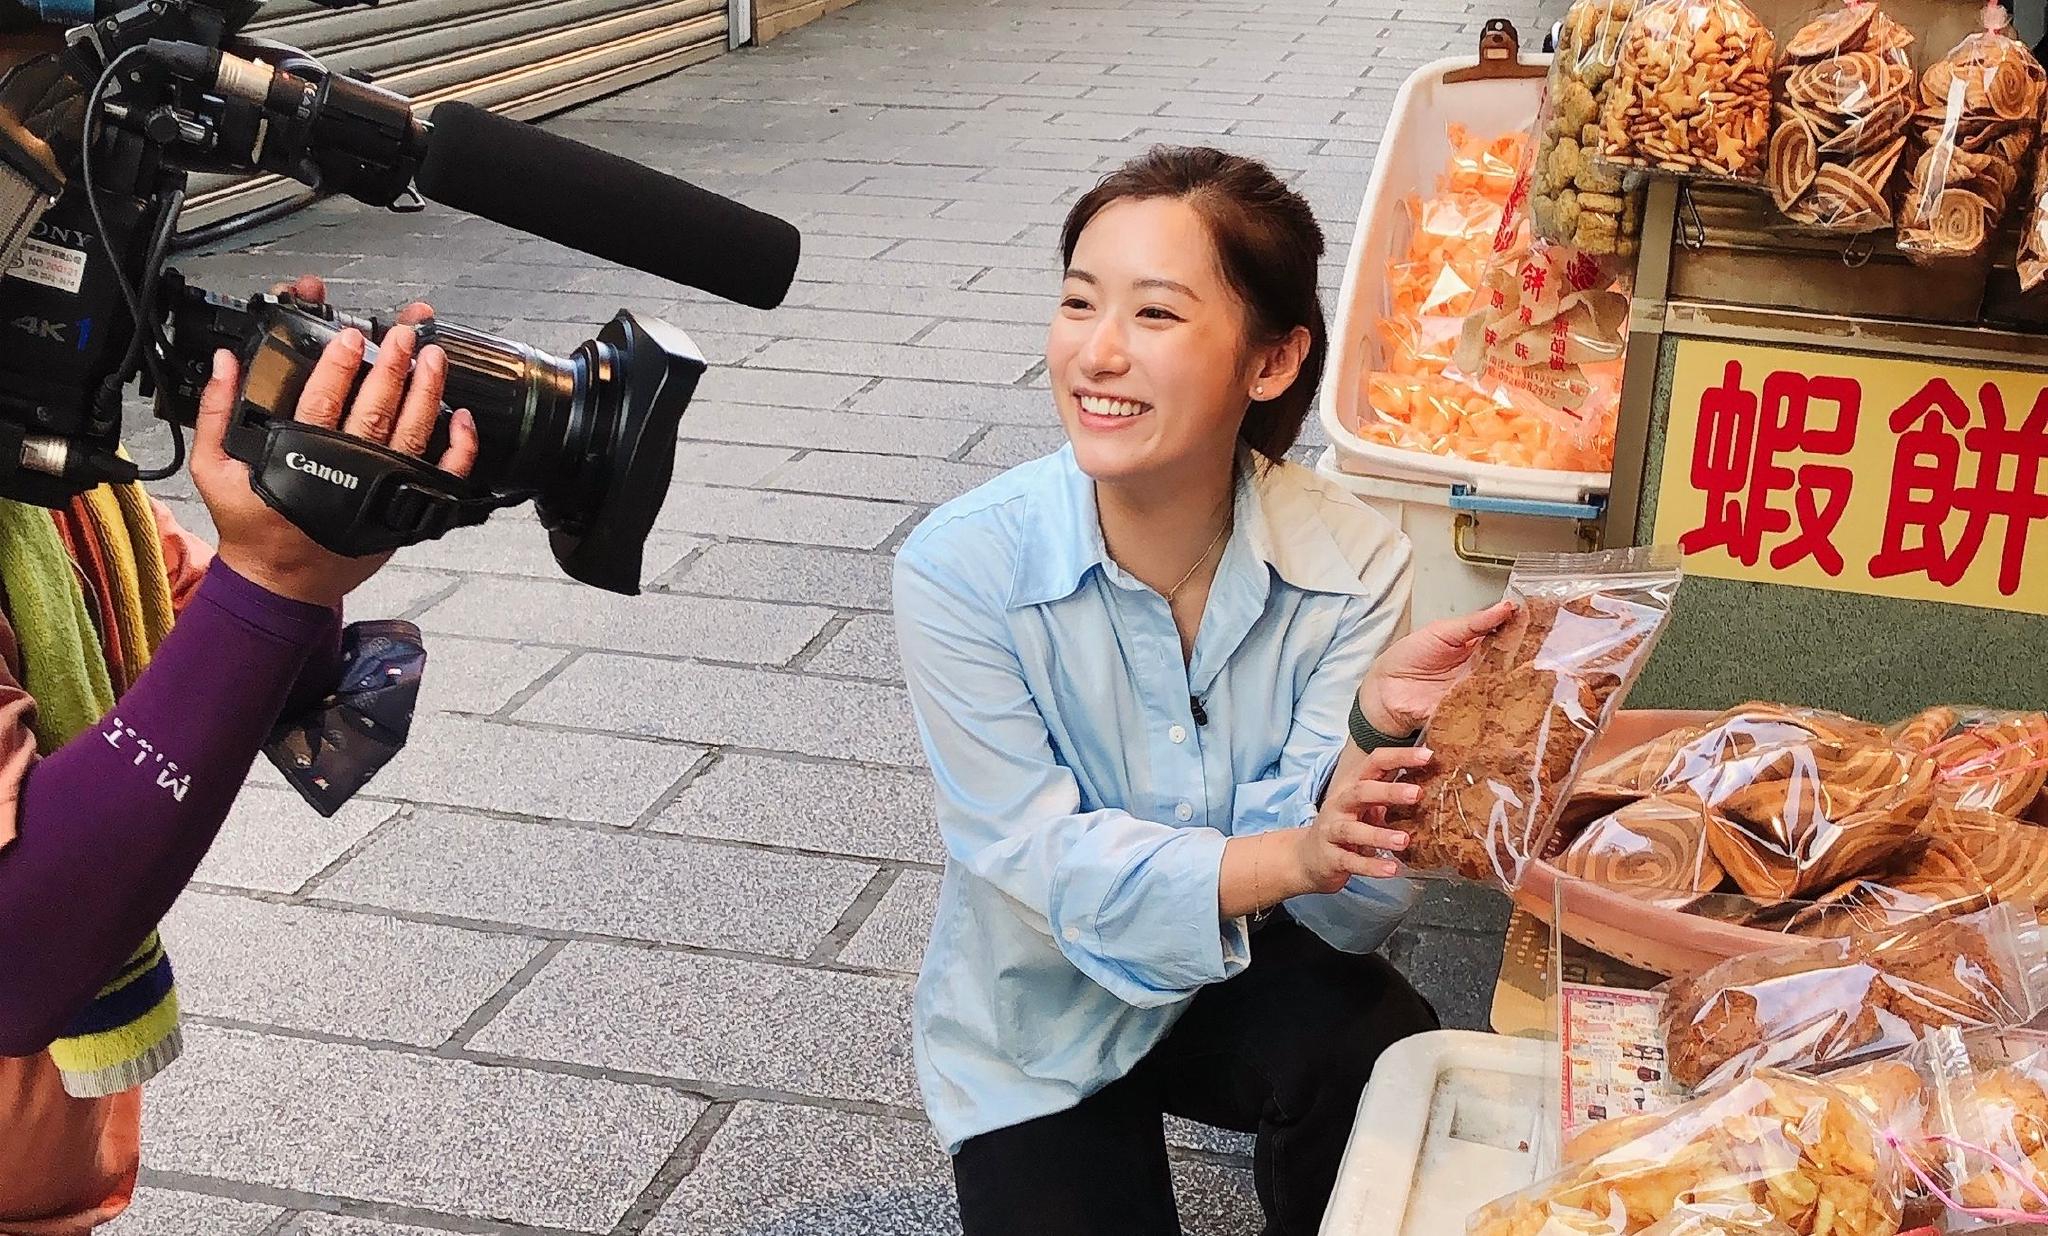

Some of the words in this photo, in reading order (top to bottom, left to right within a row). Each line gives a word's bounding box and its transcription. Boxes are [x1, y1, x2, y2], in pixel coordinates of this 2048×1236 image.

[31, 220, 95, 248] ONY
[285, 452, 359, 490] Canon
[1678, 360, 2048, 597] 蝦餅
